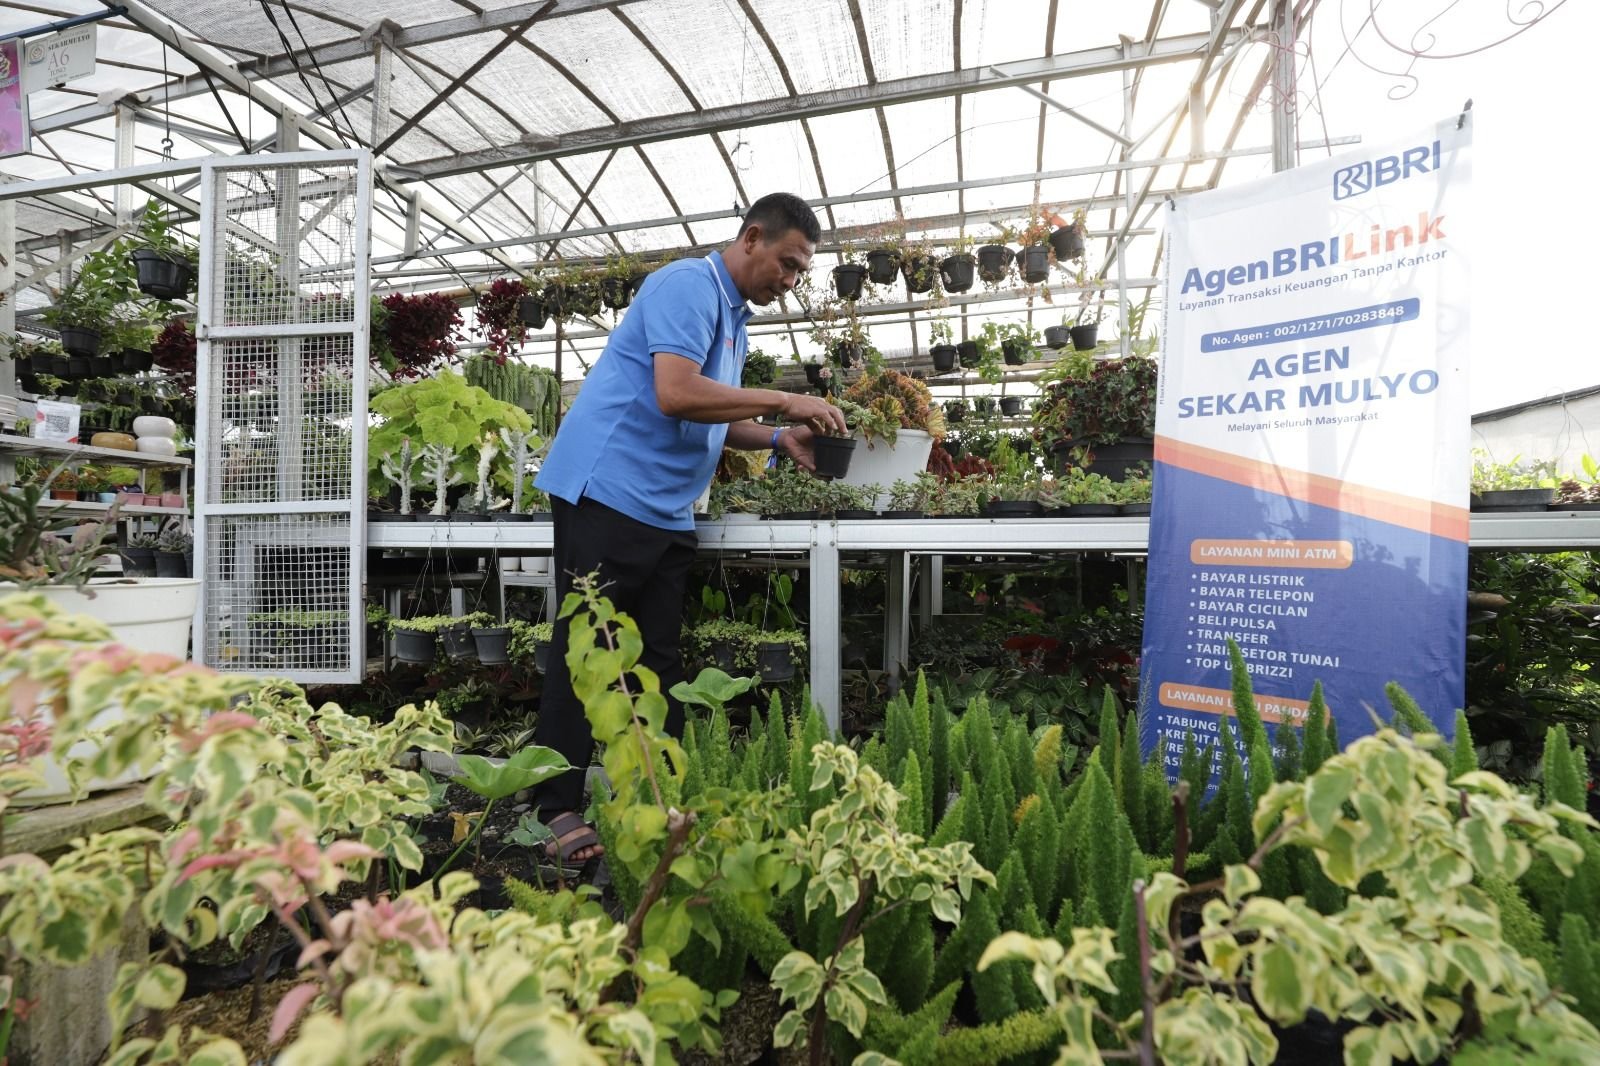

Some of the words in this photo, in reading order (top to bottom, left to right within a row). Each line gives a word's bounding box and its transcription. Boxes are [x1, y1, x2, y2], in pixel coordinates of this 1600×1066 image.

[48, 47, 70, 70] A6
[1375, 140, 1441, 187] BRI
[1180, 211, 1447, 297] AgenBRILink
[1179, 297, 1225, 311] Layanan
[1227, 285, 1281, 303] Transaksi
[1285, 272, 1348, 293] Keuangan
[1352, 263, 1393, 281] Tanpa
[1397, 249, 1448, 269] Kantor
[1212, 335, 1231, 346] No.
[1233, 331, 1263, 345] Agen
[1274, 305, 1405, 337] 002/1271/70283848
[1248, 346, 1350, 381] AGEN
[1178, 388, 1286, 419] SEKAR
[1299, 369, 1440, 408] MULYO
[1227, 420, 1271, 433] Melayani
[1274, 416, 1312, 429] Seluruh
[1315, 411, 1379, 427] Masyarakat
[1200, 546, 1263, 558] LAYANAN
[1266, 548, 1299, 559] MINI
[1304, 548, 1337, 560] ATM
[1200, 572, 1246, 583] BAYAR
[1250, 574, 1305, 586] LISTRIK
[1200, 586, 1245, 598] BAYAR
[1249, 588, 1314, 602] TELEPON
[1199, 600, 1244, 613] BAYAR
[1248, 603, 1308, 617] CICILAN
[1198, 614, 1227, 626] BELI
[1230, 617, 1276, 630] PULSA
[1197, 629, 1269, 644] TRANSFER
[1196, 643, 1287, 661] TARISETOR
[1291, 652, 1340, 667] TUNAI
[1195, 657, 1221, 669] TOP
[1246, 663, 1293, 678] BRIZZI
[1167, 689, 1224, 706] LAYANAN
[1166, 715, 1237, 735] TABUNGN
